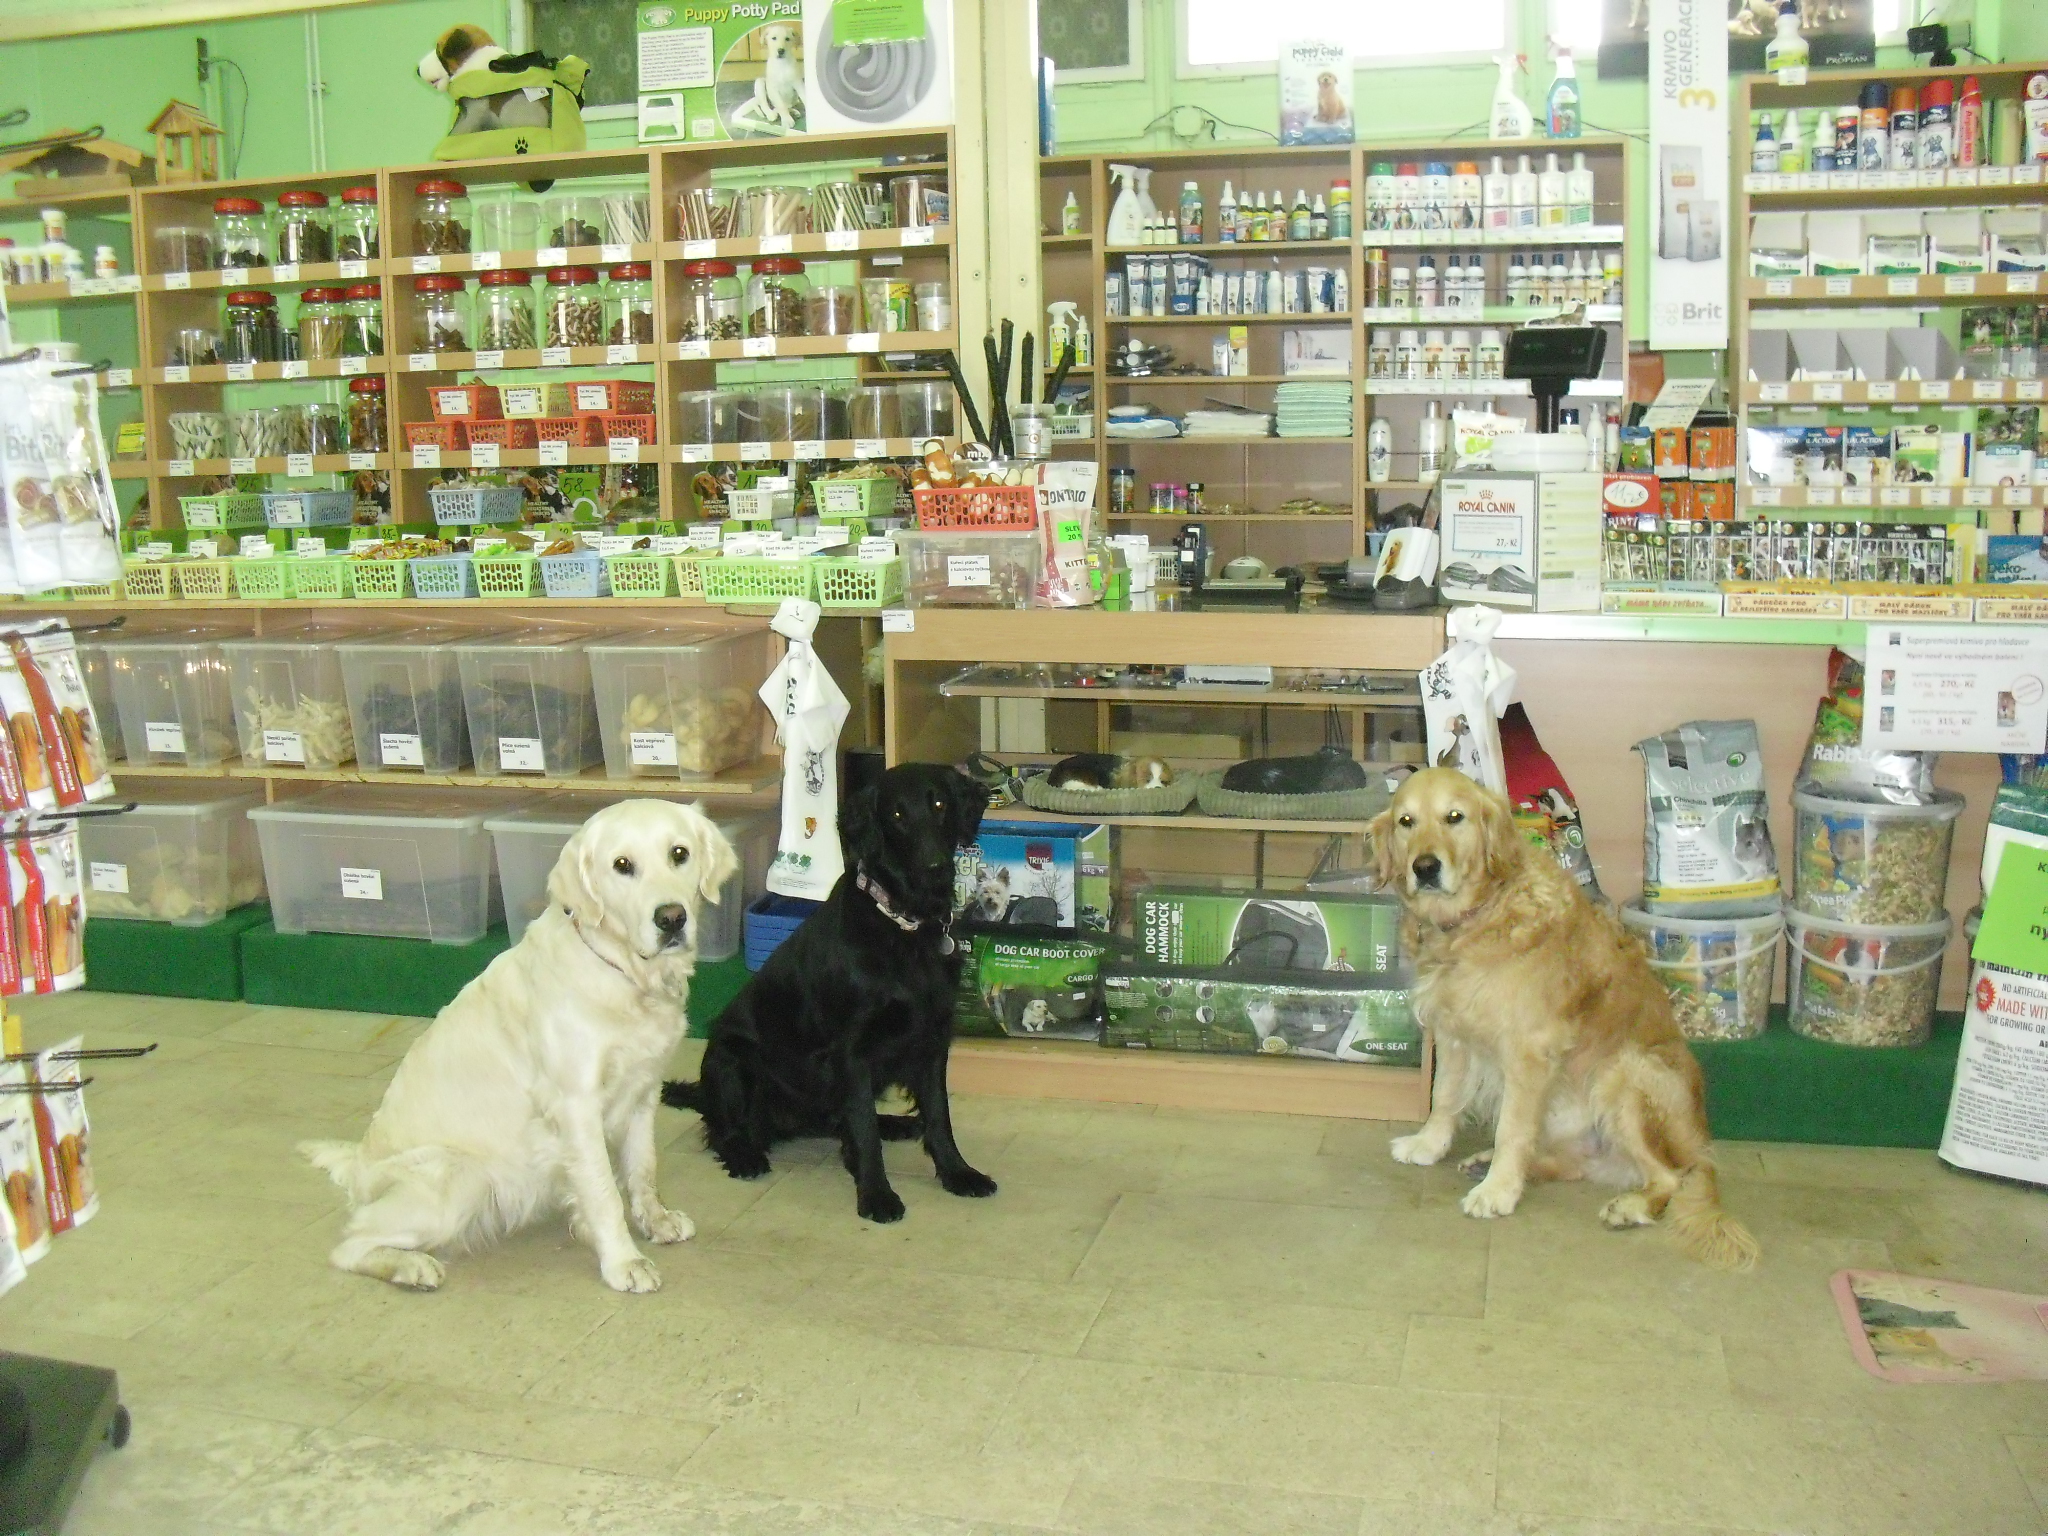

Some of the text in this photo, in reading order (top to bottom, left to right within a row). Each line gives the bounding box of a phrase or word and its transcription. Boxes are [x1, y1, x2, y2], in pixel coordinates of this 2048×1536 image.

[685, 8, 729, 24] Puppy
[732, 4, 769, 20] Potty
[772, 1, 800, 16] Pad
[1679, 0, 1692, 87] GENERAC
[1663, 30, 1677, 99] KRMIVO
[1679, 88, 1716, 112] 3
[1683, 302, 1722, 319] Brit
[1460, 427, 1485, 435] ROYAL
[1459, 501, 1516, 514] ROYAL CANIN
[1496, 538, 1517, 547] 27,- Kč
[1985, 639, 1997, 647] pro
[1964, 679, 1975, 688] Kč
[1962, 717, 1972, 725] Kč
[1671, 770, 1750, 794] selective
[1029, 856, 1050, 865] TRIXIE
[1146, 901, 1156, 954] DOG CAR
[1158, 902, 1169, 963] HAMMOCK
[995, 944, 1105, 959] DOG CAR BOOT COVER
[1068, 974, 1093, 983] CARGO
[2002, 983, 2048, 999] NO ARTIFICIAL
[1997, 998, 2026, 1016] MADE
[2000, 1018, 2033, 1032] GROWING
[2036, 1025, 2046, 1034] OR
[1366, 1042, 1408, 1051] ONE-SEAT
